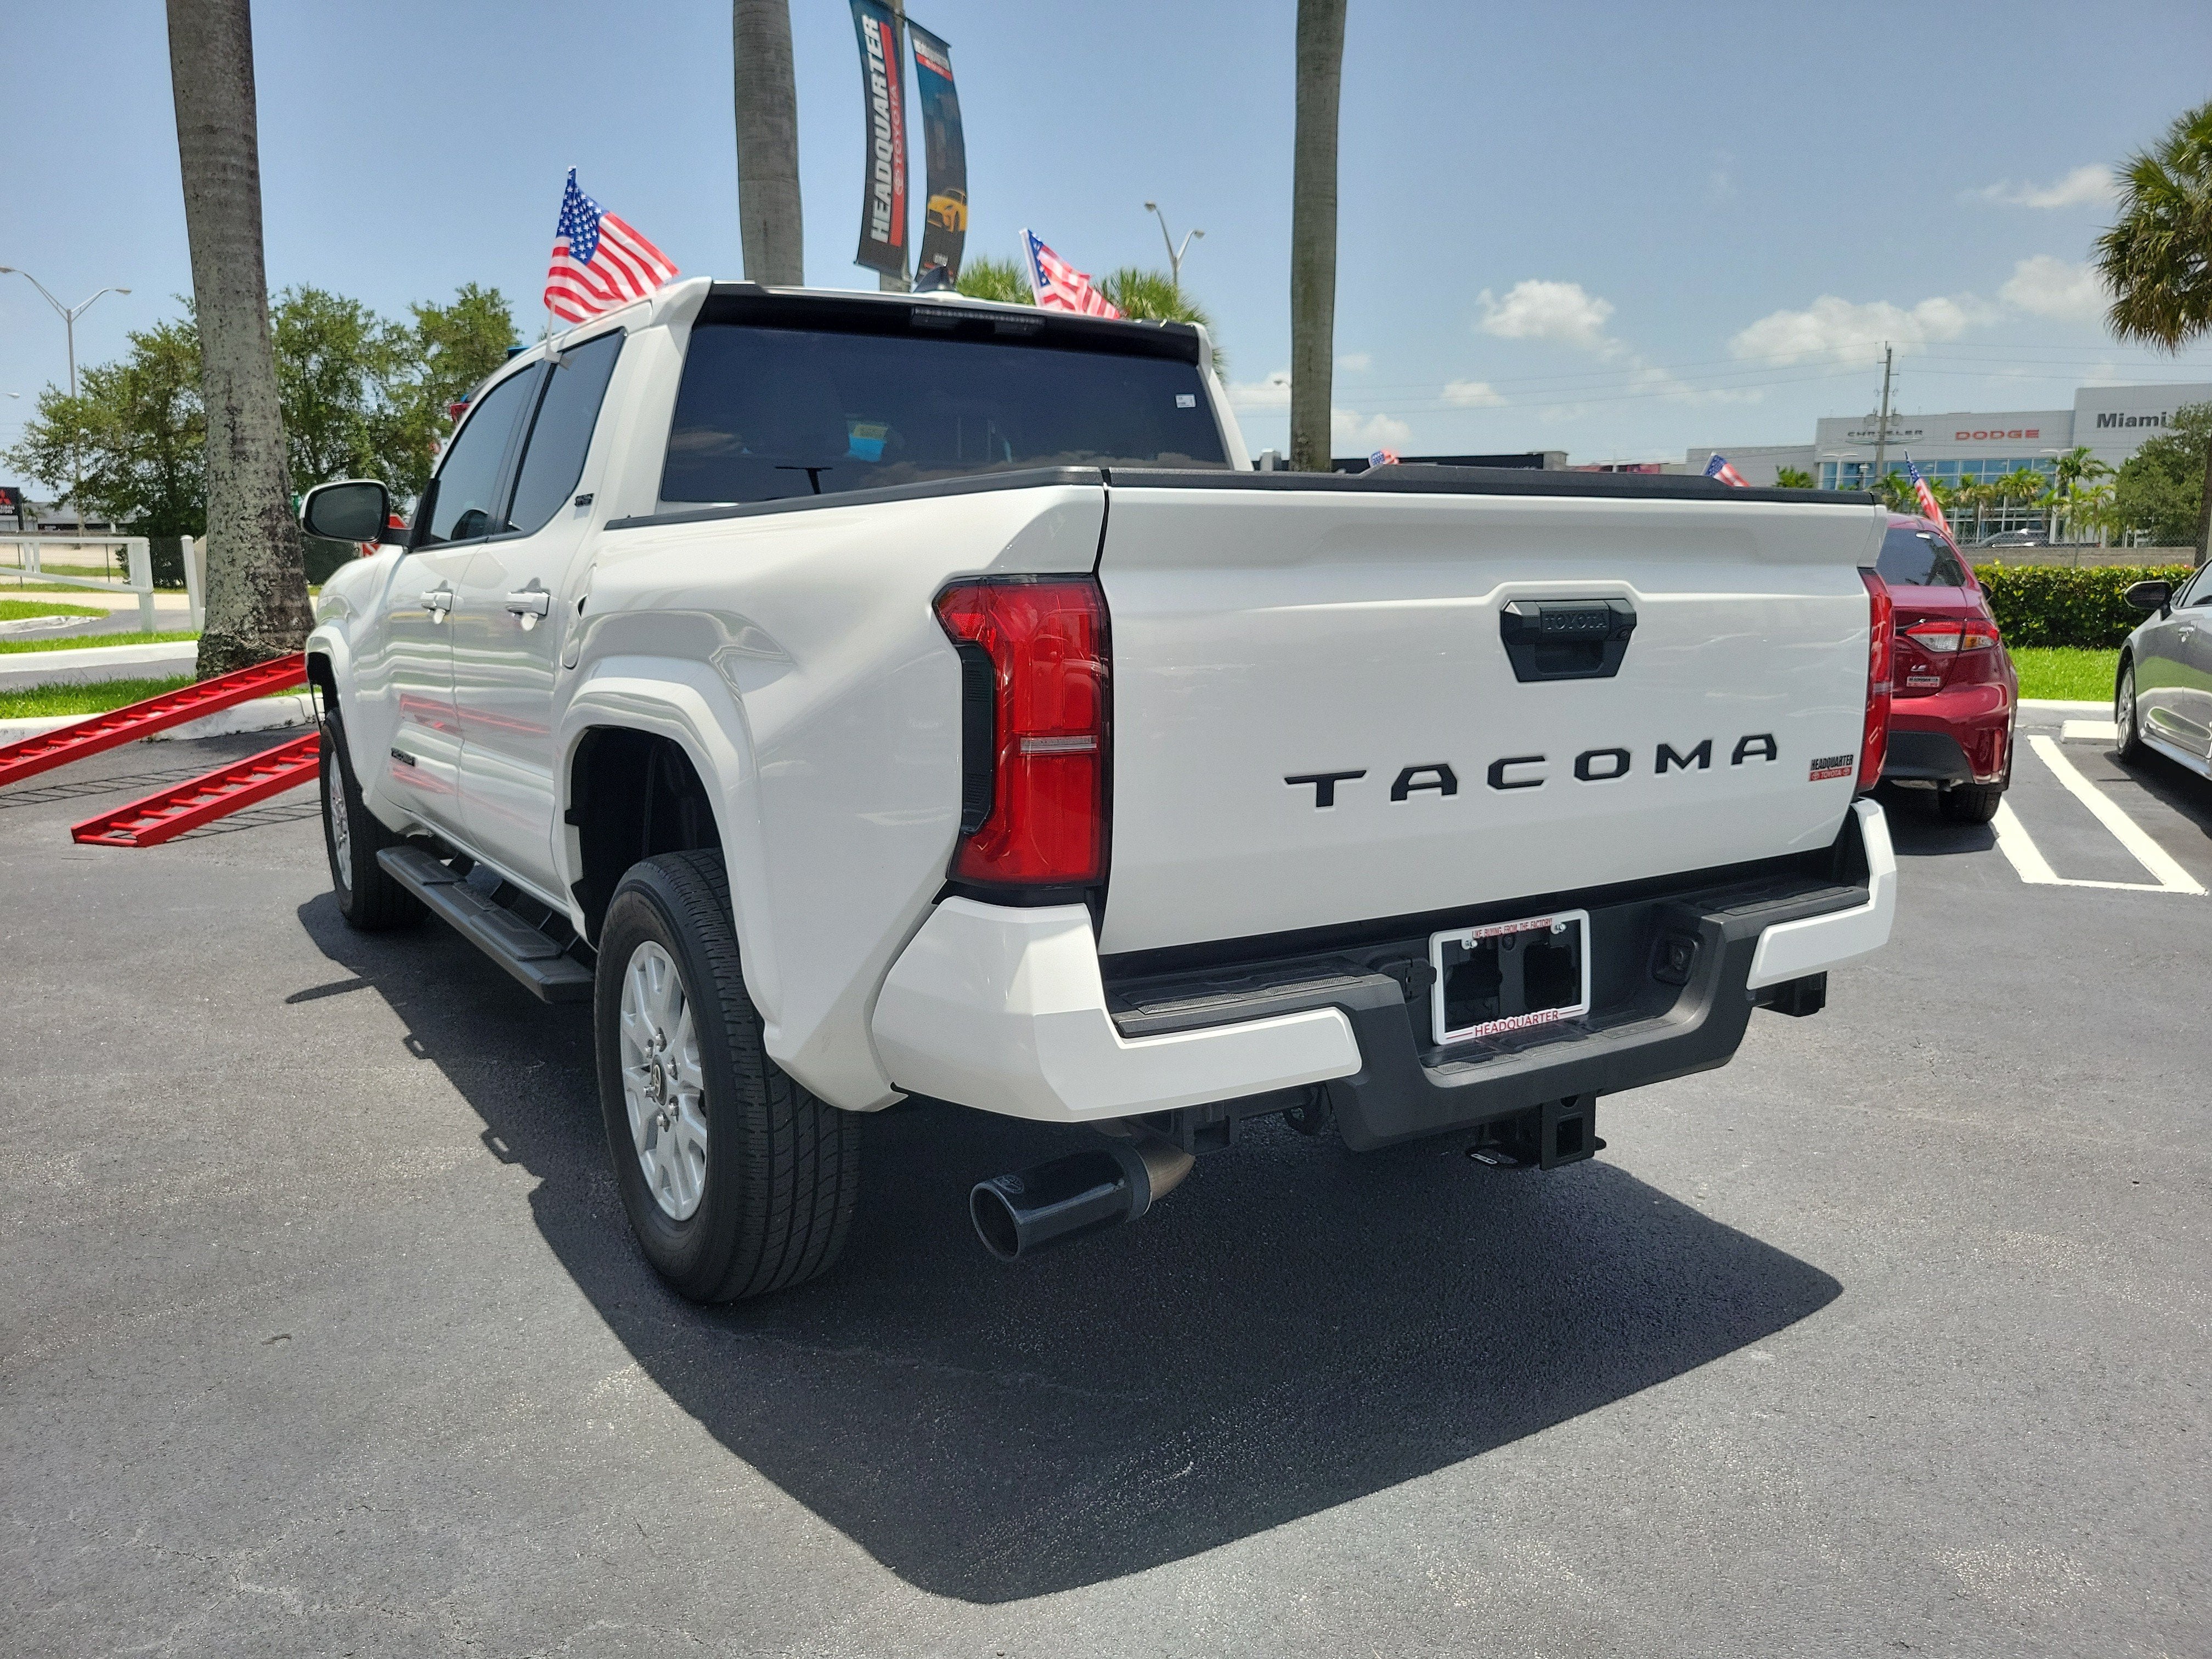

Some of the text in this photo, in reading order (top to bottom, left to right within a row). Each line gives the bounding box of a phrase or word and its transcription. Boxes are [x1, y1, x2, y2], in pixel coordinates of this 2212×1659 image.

[862, 14, 892, 243] HEADQUARTER
[889, 85, 903, 164] TOYOTA
[2097, 411, 2168, 428] Miami
[1955, 430, 2039, 441] DODGE
[1545, 613, 1607, 630] TOYOTA
[1284, 733, 1777, 808] TACOMA
[1504, 924, 1517, 934] FROM
[1520, 922, 1529, 931] THE
[1475, 1010, 1559, 1036] HEADQUARTER
